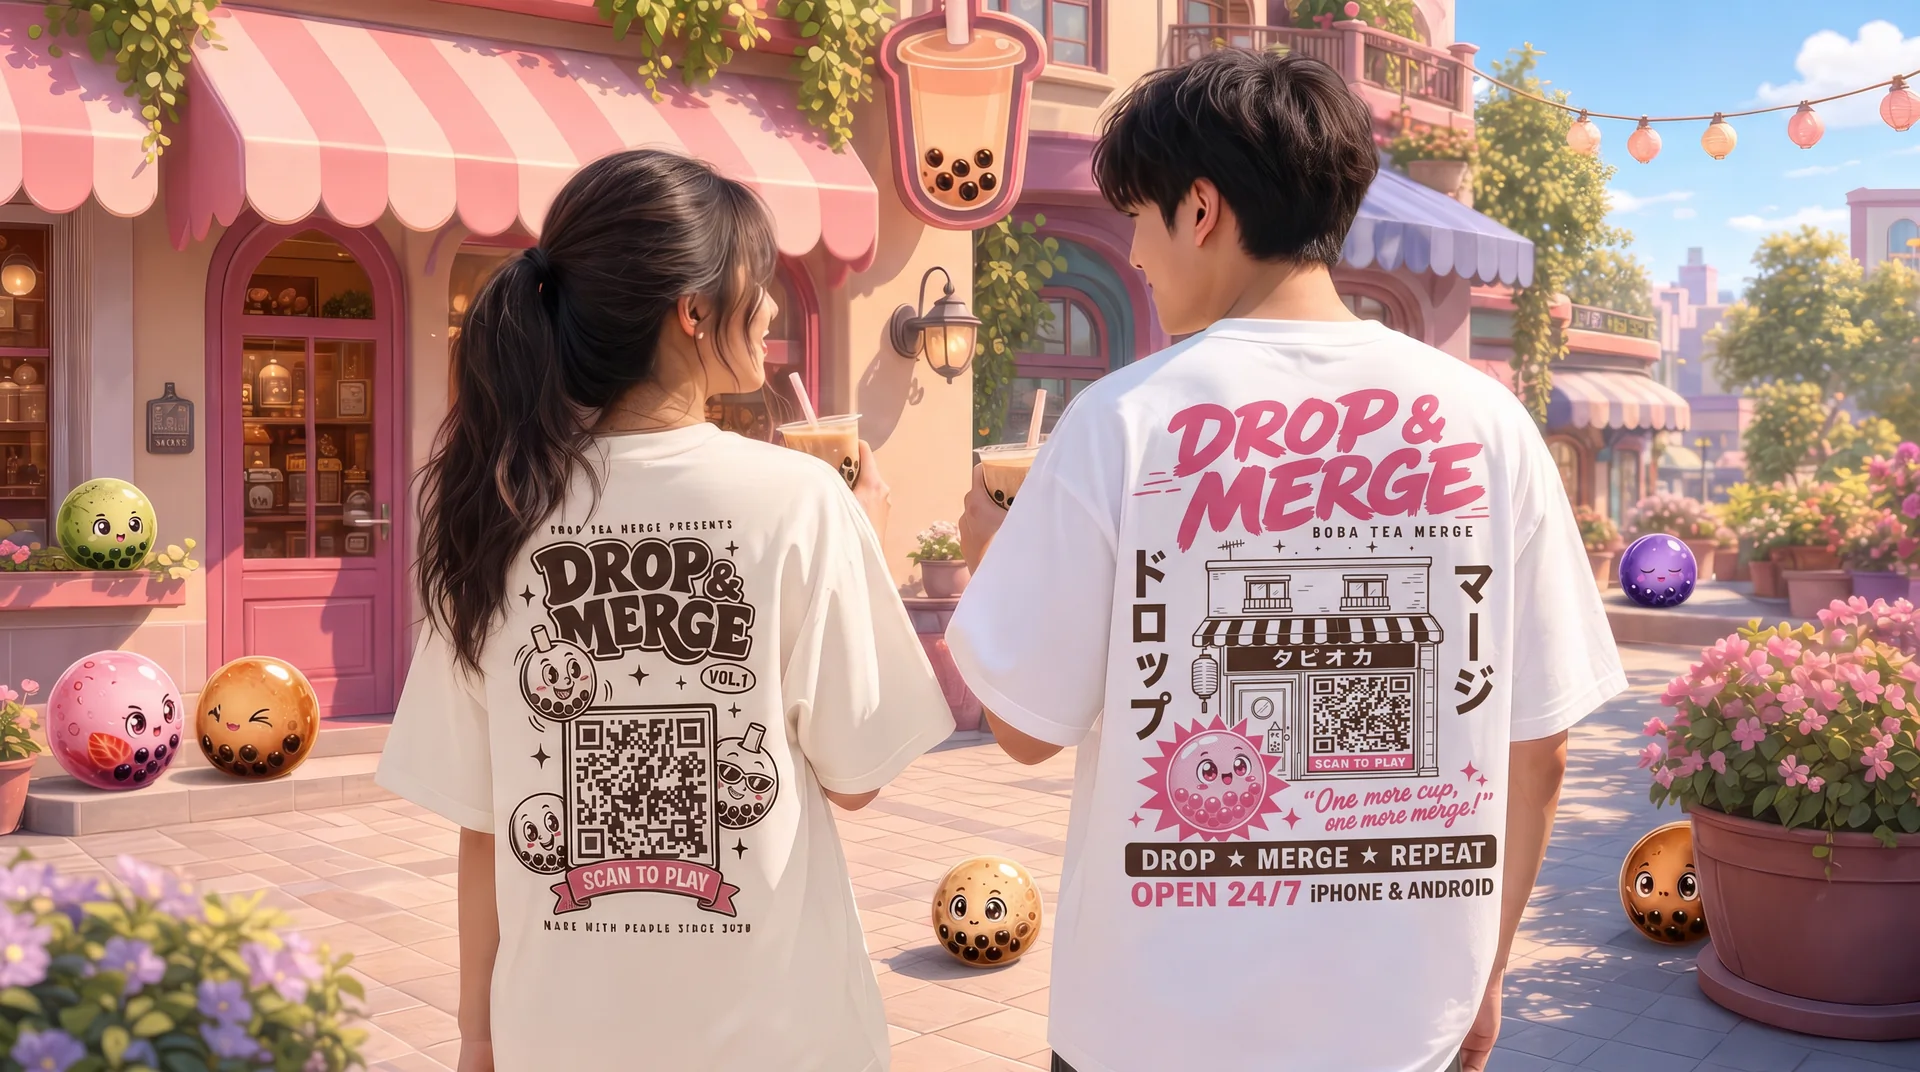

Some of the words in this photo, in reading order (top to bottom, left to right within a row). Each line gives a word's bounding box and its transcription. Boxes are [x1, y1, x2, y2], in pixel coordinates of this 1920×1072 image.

[1167, 388, 1399, 478] DROP
[1401, 394, 1446, 444] &
[1176, 442, 1485, 553] MERGE
[669, 519, 733, 531] PRESENTS
[1312, 526, 1359, 539] BOBA
[1370, 525, 1403, 539] TEA
[1414, 525, 1474, 538] MERGE
[532, 539, 713, 607] DROP
[704, 559, 744, 603] &
[550, 593, 755, 663] MERGE
[1454, 565, 1495, 716] マージ
[1130, 549, 1172, 741] ドロップ
[1273, 649, 1374, 668] タピオカ
[709, 669, 748, 688] VOL.1
[1314, 757, 1349, 769] SCAN
[1354, 757, 1370, 768] TO
[1374, 757, 1406, 768] PLAY
[1363, 787, 1412, 807] more
[1417, 782, 1459, 804] cup,
[1324, 815, 1358, 832] one
[1361, 810, 1406, 828] more
[1141, 849, 1216, 871] DROP
[1257, 846, 1350, 869] MERGE
[1391, 841, 1486, 866] REPEAT
[583, 866, 631, 891] SCAN
[635, 865, 659, 884] TO
[665, 866, 710, 892] PLAY
[1131, 881, 1217, 907] OPEN
[1227, 880, 1302, 907] 24/7
[1310, 883, 1383, 903] iPHONE
[1387, 882, 1404, 901] &
[1406, 877, 1494, 900] ANDROID
